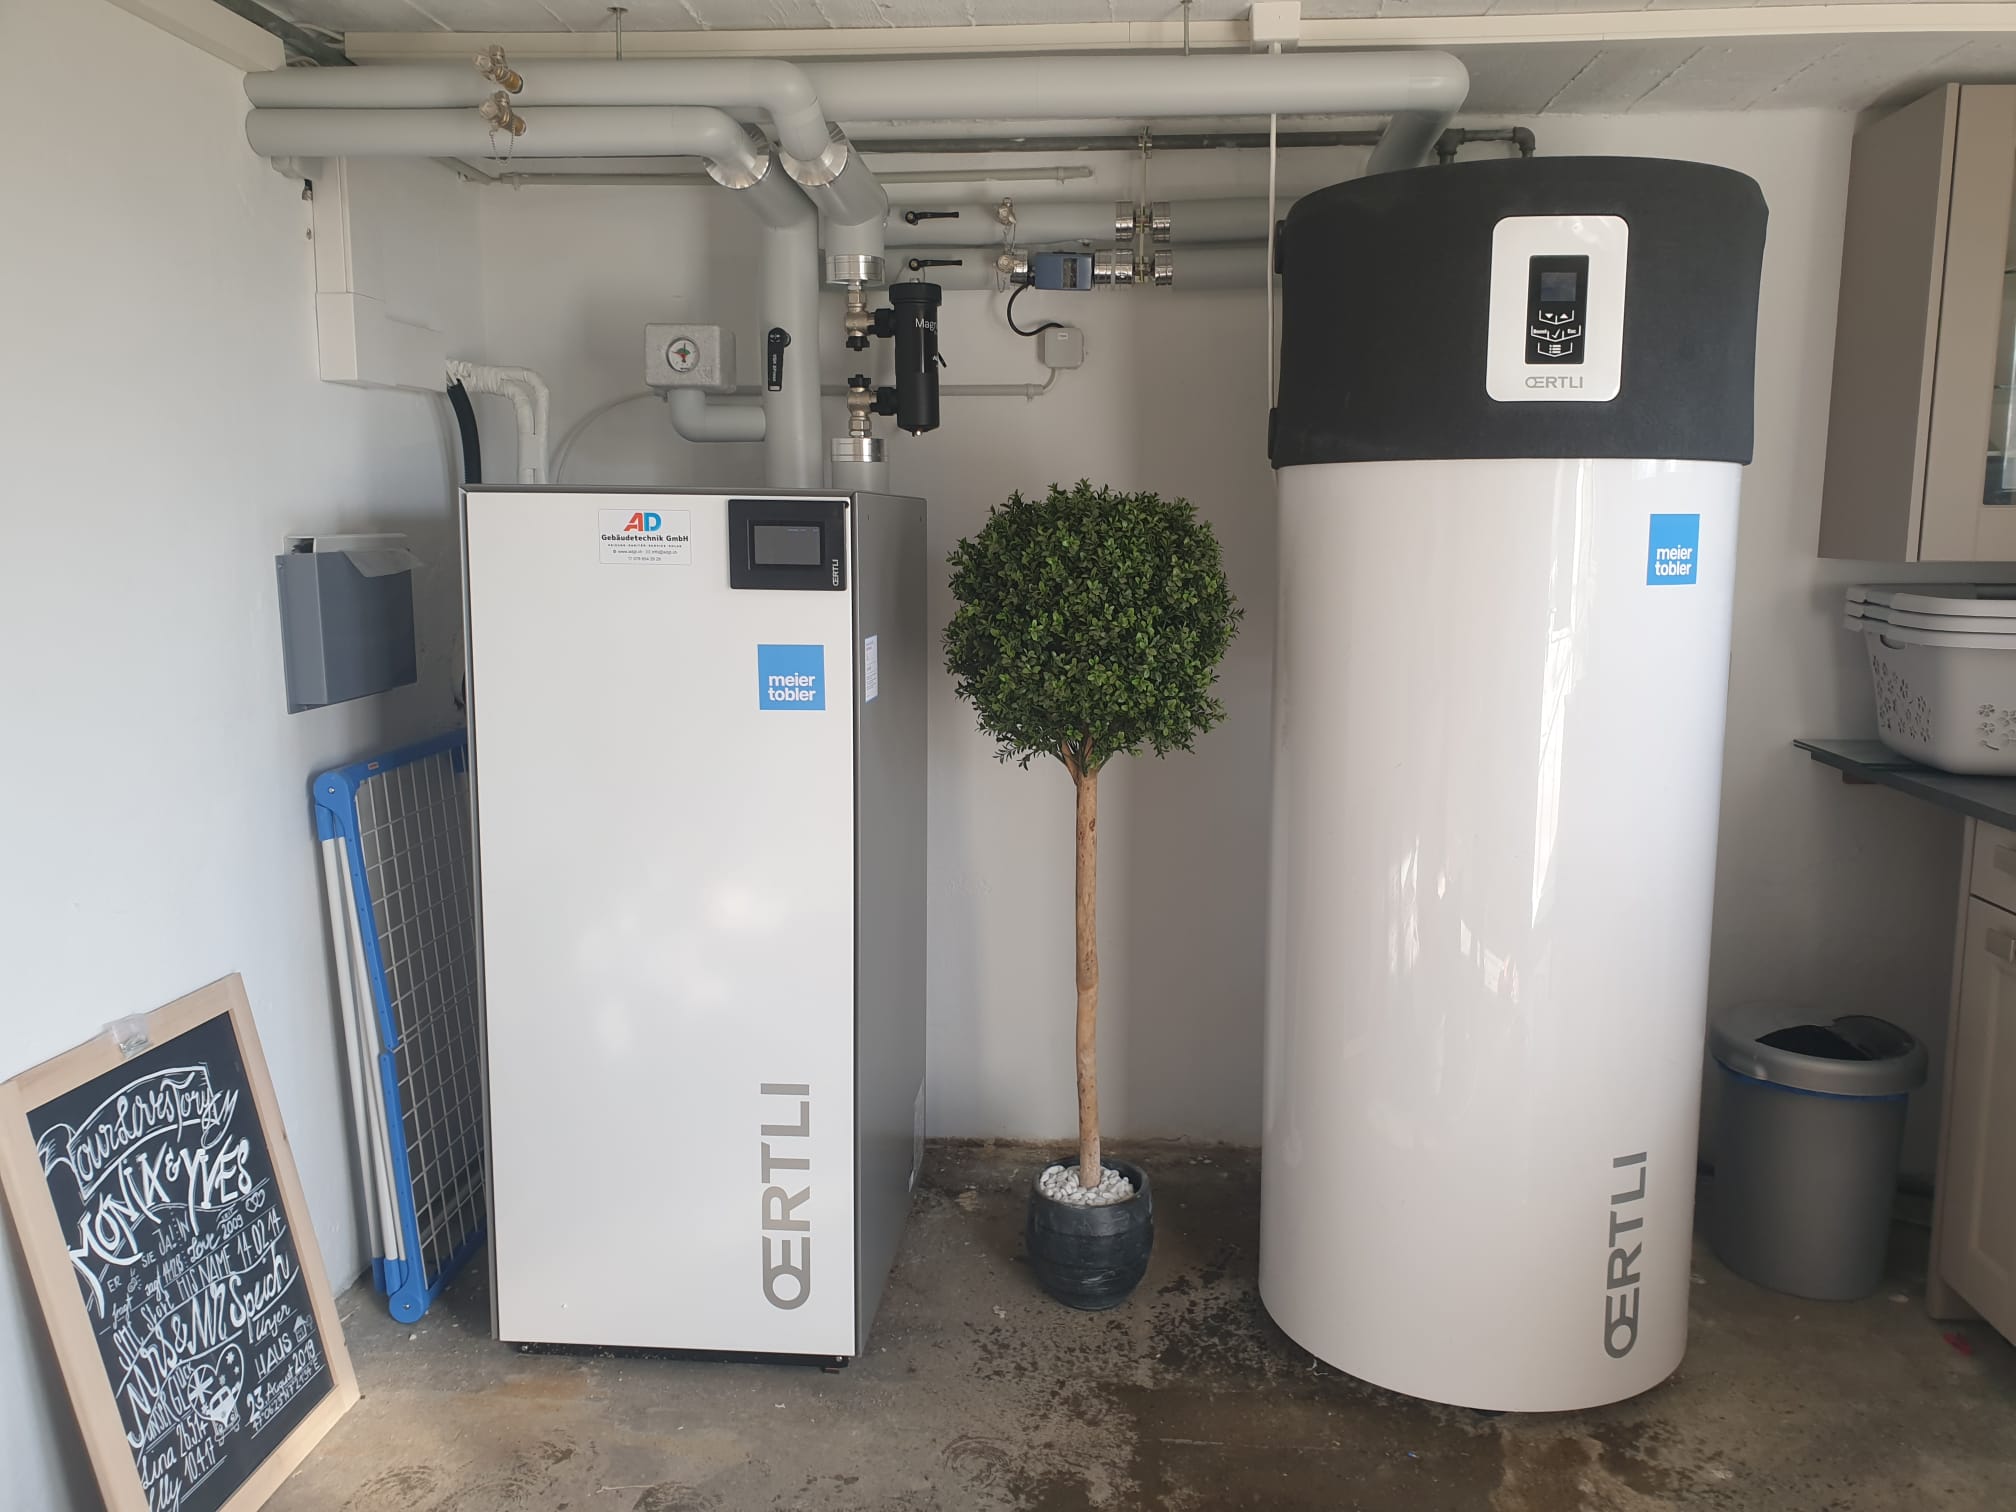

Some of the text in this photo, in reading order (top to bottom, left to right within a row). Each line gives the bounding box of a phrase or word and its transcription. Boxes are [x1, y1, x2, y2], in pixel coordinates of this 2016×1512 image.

[601, 533, 689, 542] Gebäudetechnik GmbH
[623, 512, 662, 532] AD
[1656, 544, 1692, 560] meier
[1655, 561, 1692, 576] tobler
[768, 672, 815, 687] meier
[768, 687, 816, 701] tobler
[165, 1147, 181, 1182] &
[179, 1135, 252, 1236] YVES
[187, 1233, 221, 1263] Love
[222, 1214, 243, 1240] 2009
[107, 1275, 122, 1293] ER
[141, 1251, 157, 1268] SIE
[198, 1244, 230, 1288] NAME
[255, 1333, 292, 1378] HAUS
[265, 1364, 294, 1402] August
[292, 1339, 316, 1375] 2019
